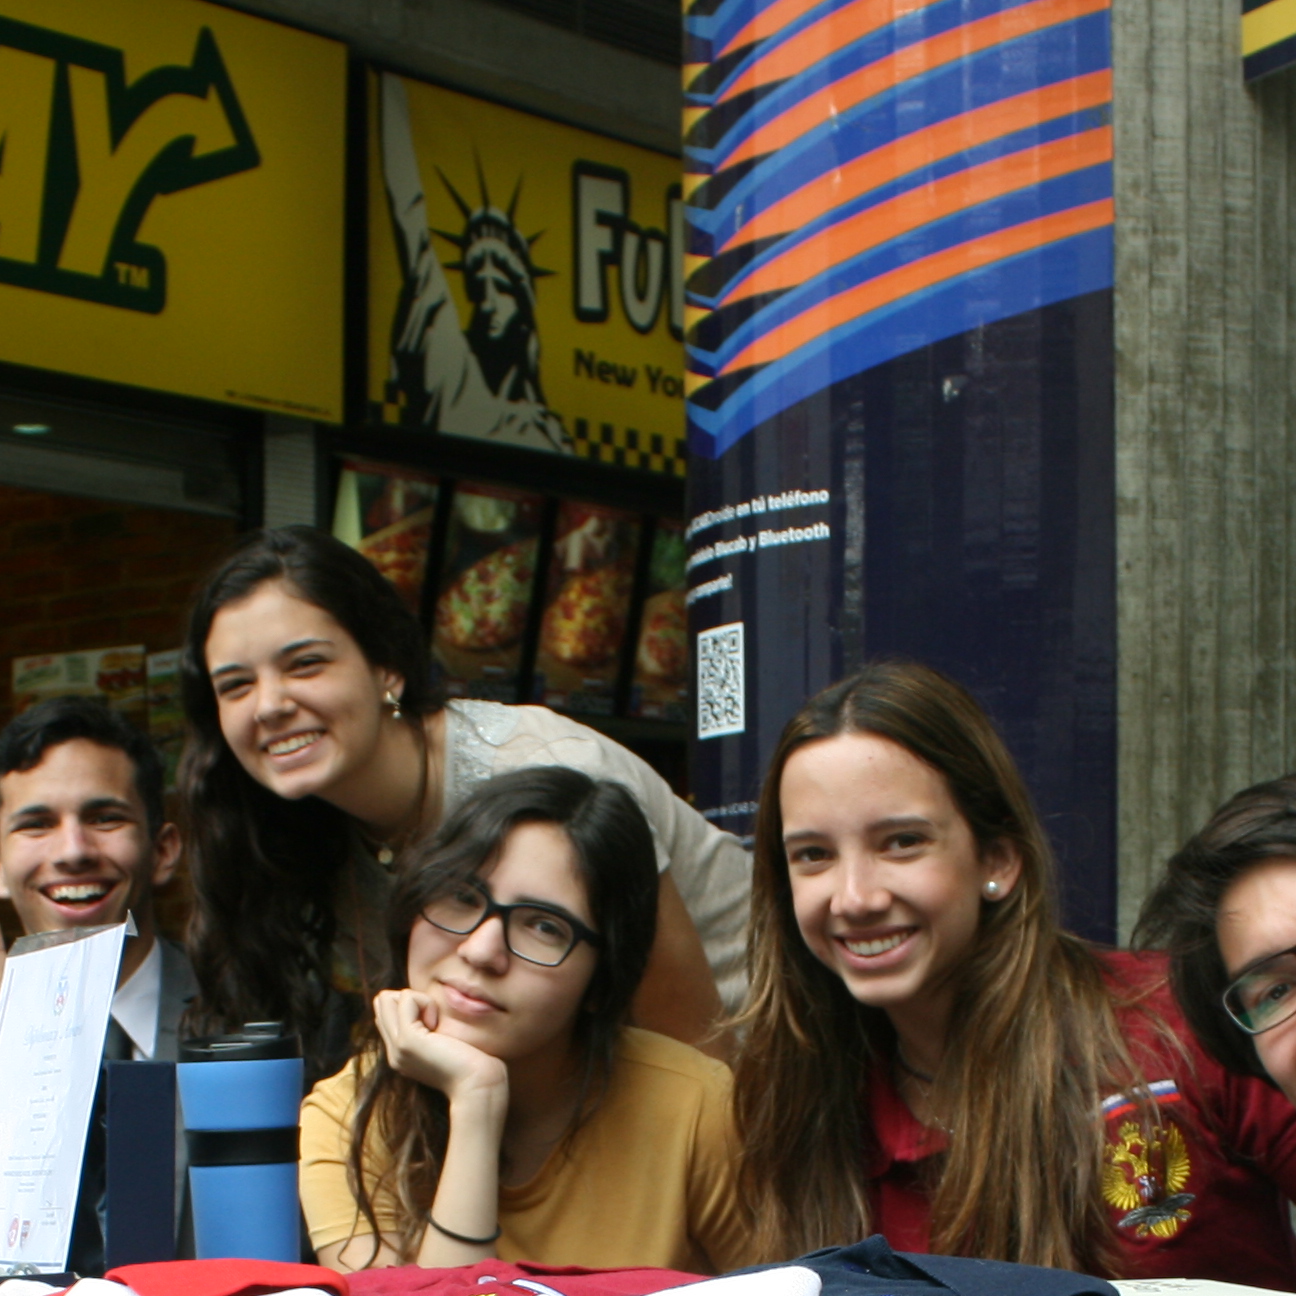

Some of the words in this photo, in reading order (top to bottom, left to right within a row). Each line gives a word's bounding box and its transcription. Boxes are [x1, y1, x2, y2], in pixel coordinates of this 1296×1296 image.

[572, 347, 639, 388] New
[767, 488, 830, 512] teléfono
[758, 522, 830, 549] Bluetooth
